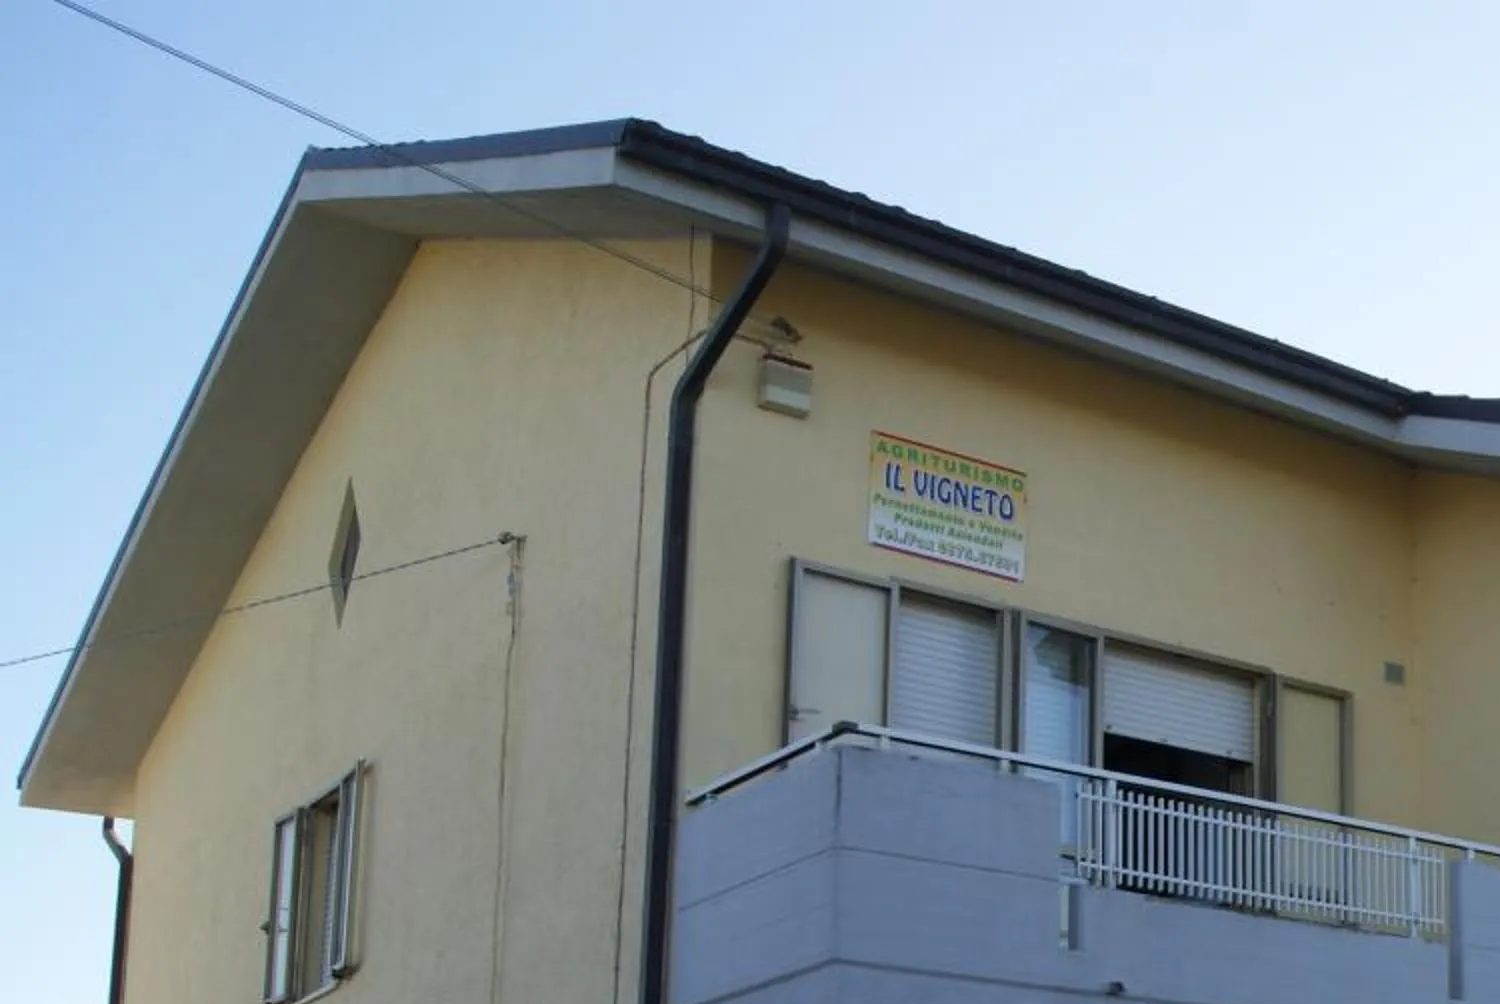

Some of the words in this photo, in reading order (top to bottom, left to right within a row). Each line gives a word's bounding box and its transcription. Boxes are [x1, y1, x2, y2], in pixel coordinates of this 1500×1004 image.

[876, 439, 1025, 493] AGRITURISMO
[885, 461, 905, 492] IL
[913, 468, 1015, 520] VIGNETO
